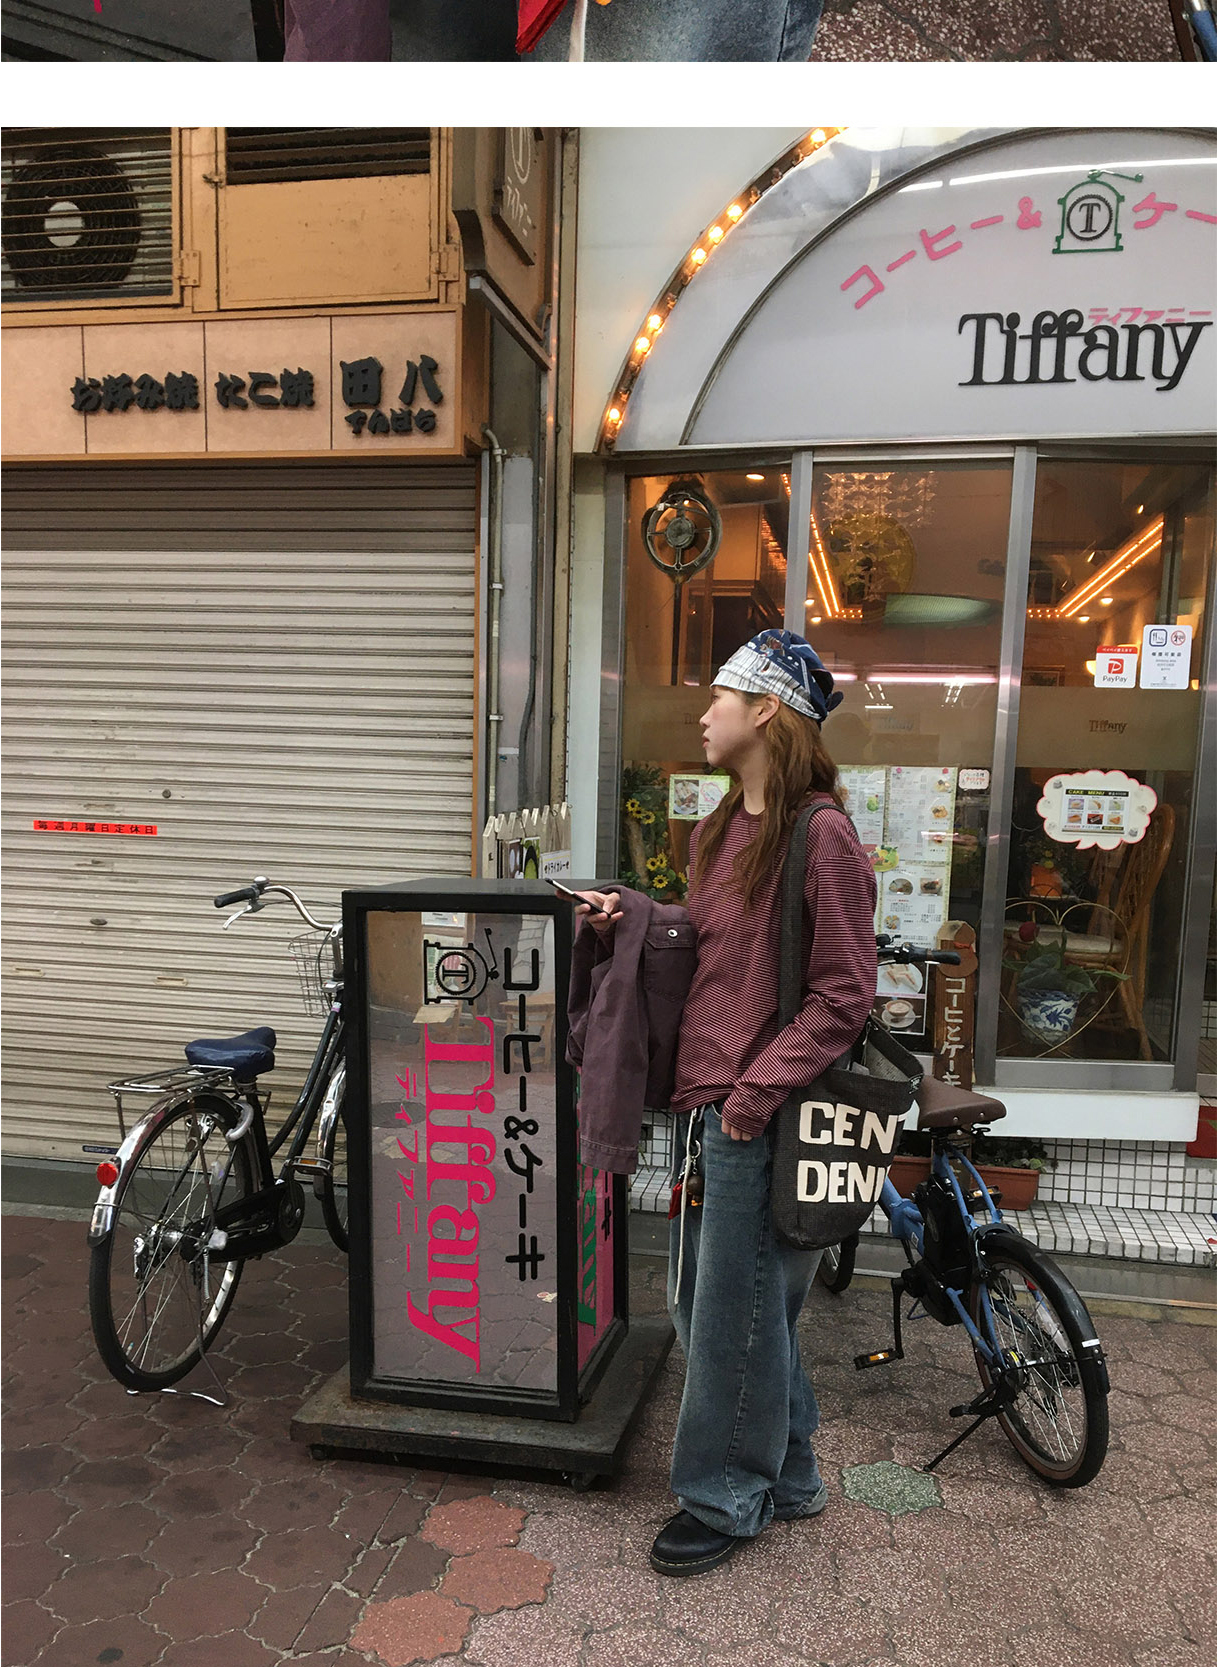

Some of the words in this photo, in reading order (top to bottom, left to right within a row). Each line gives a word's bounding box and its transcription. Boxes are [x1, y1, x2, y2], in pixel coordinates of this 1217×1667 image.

[958, 308, 1213, 391] Tiffany
[1089, 720, 1127, 734] Tiffany
[38, 821, 154, 834] 毎週月曜日定休日
[799, 1101, 906, 1154] CEN
[407, 1016, 497, 1373] Tiffany
[797, 1160, 890, 1202] DENI
